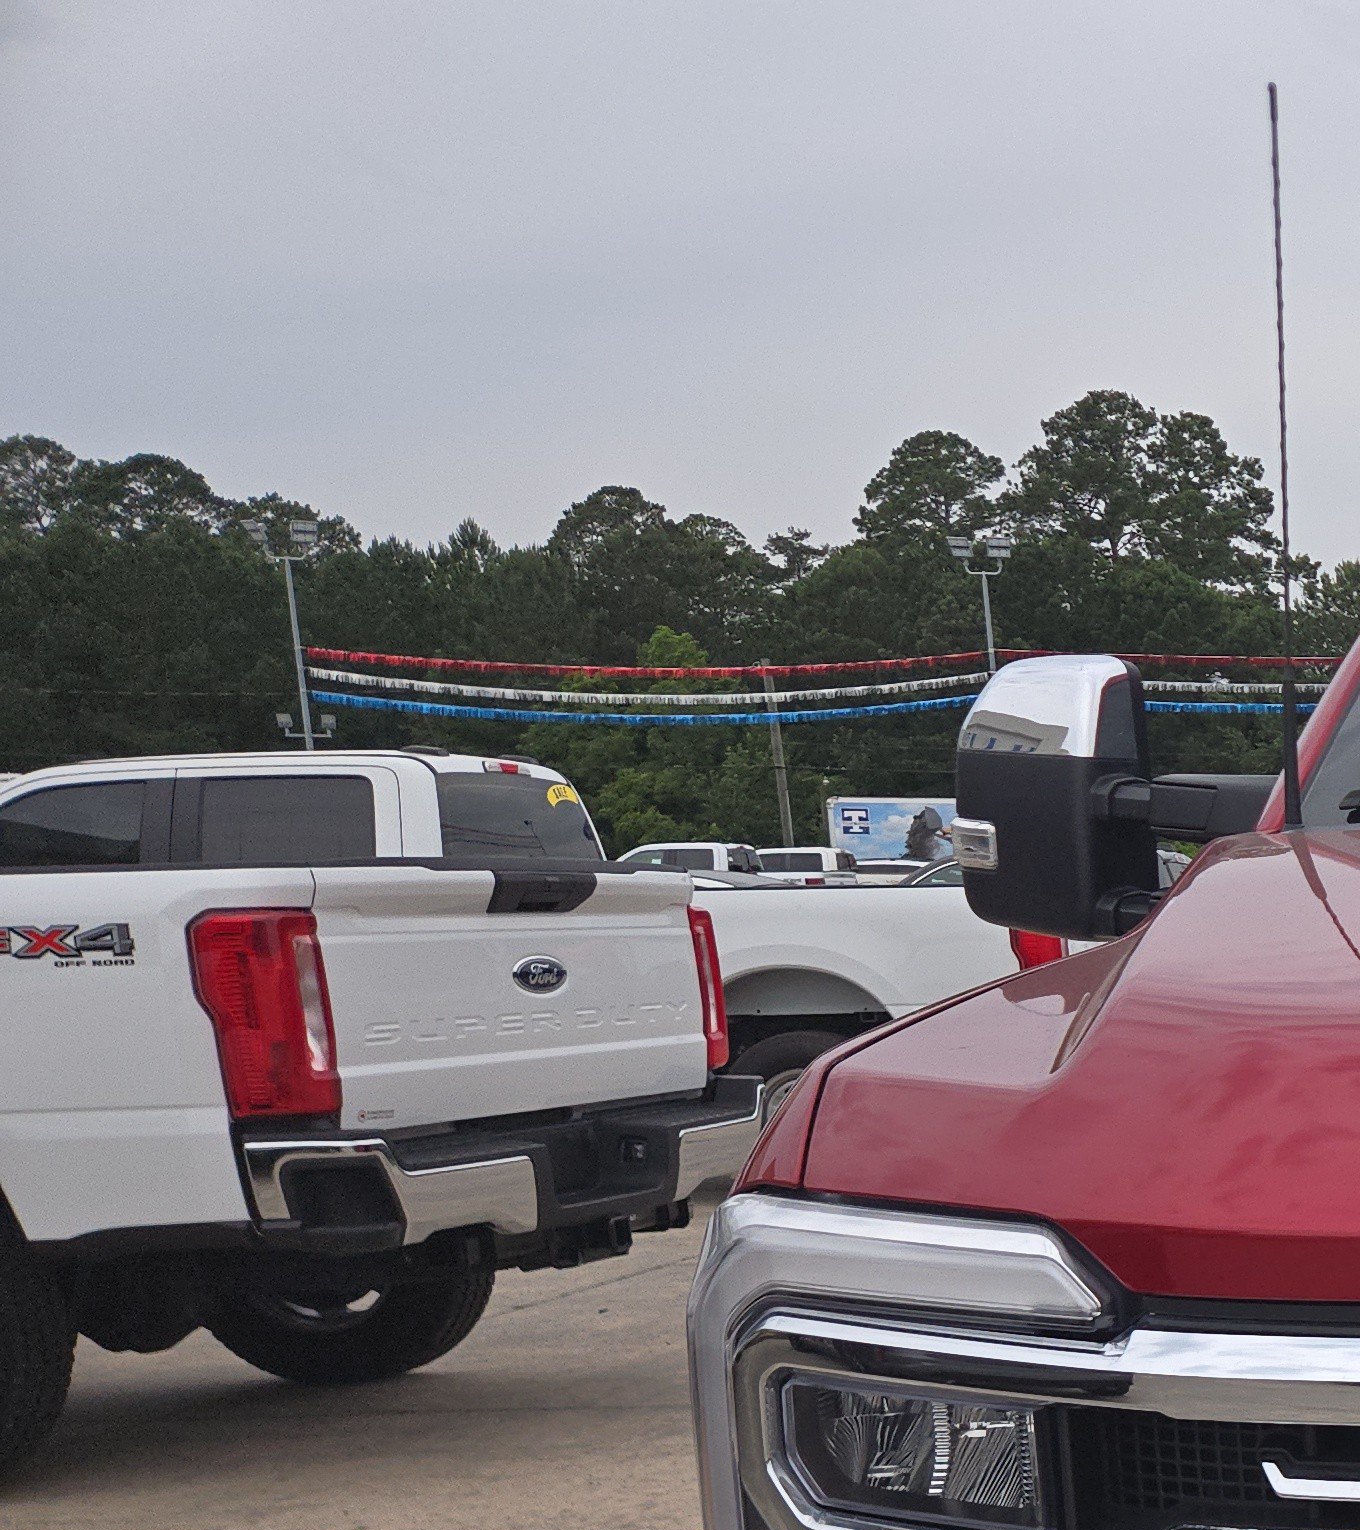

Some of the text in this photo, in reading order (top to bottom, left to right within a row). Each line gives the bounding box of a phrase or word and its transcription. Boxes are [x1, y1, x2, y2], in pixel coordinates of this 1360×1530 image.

[0, 923, 135, 958] X4
[54, 959, 135, 968] OFF ROAD
[528, 963, 558, 985] Ford
[364, 1002, 687, 1046] SUPER DUTY
